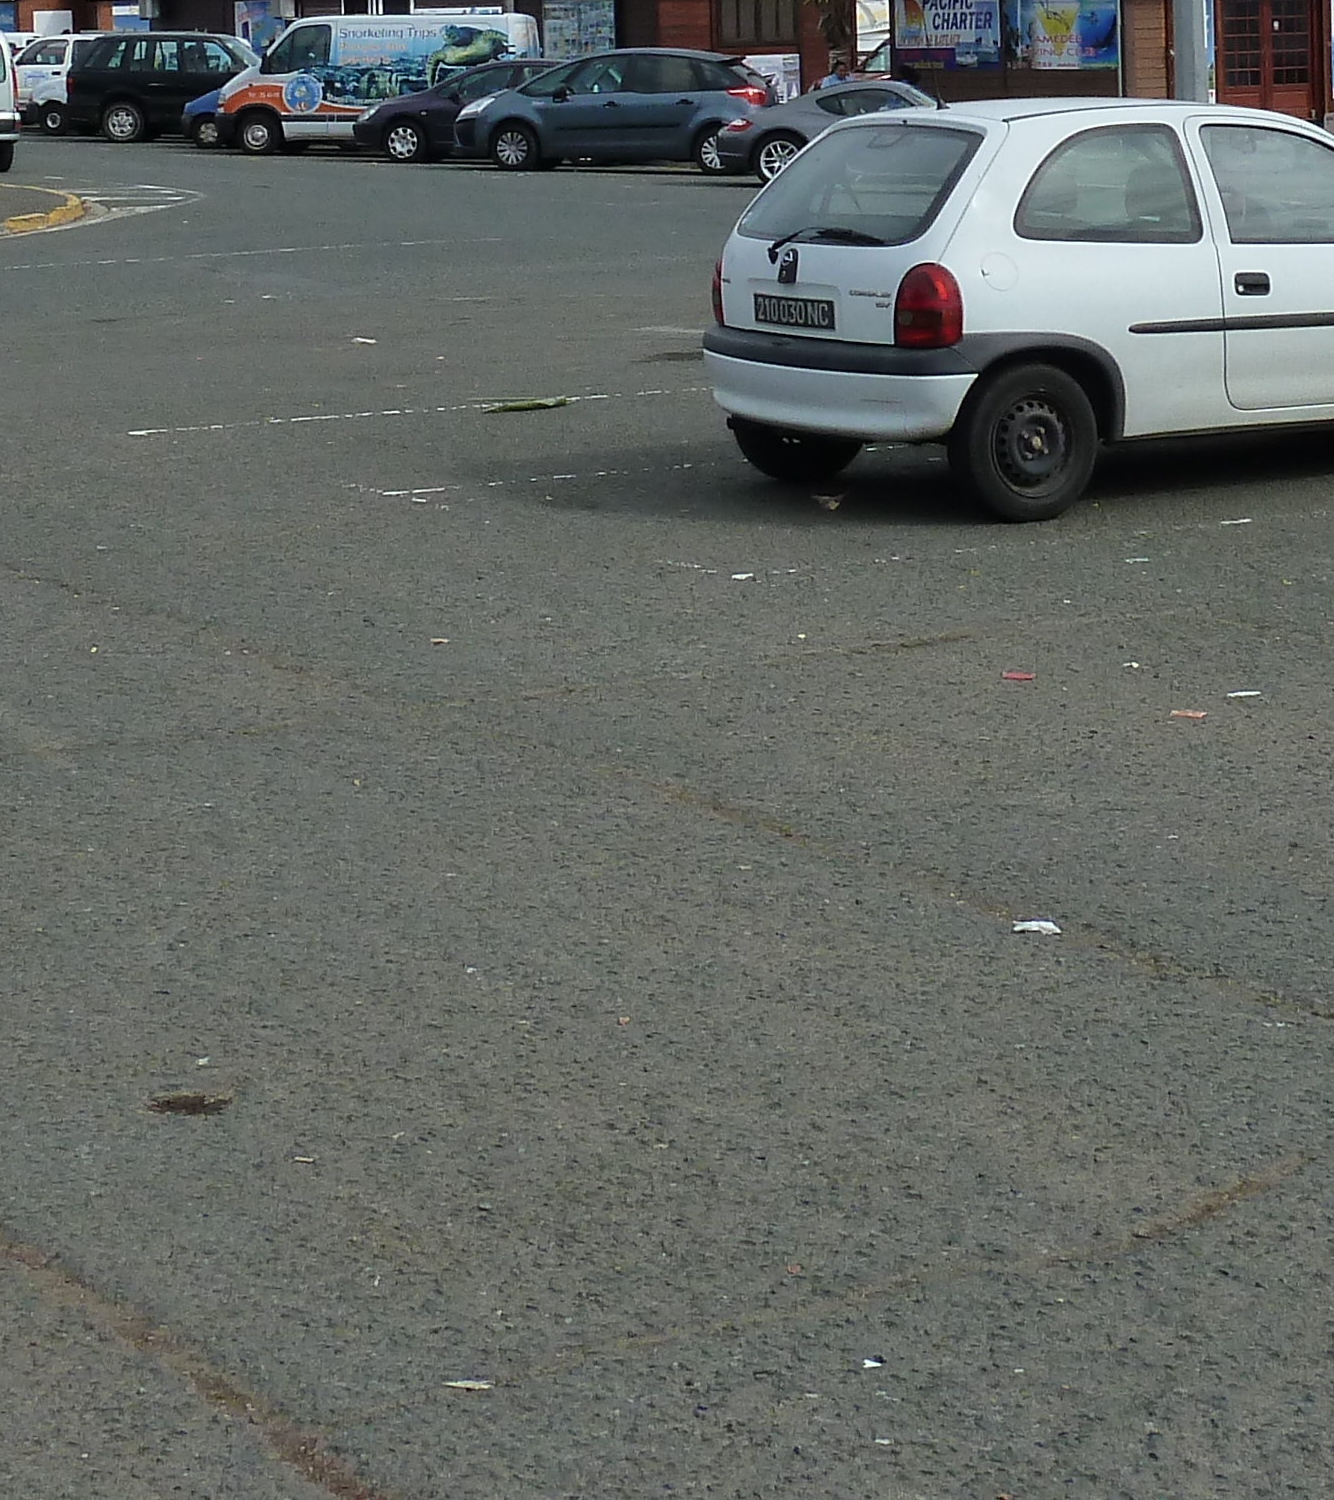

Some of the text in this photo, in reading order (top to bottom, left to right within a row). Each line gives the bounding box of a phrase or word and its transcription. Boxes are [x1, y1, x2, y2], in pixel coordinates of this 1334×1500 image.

[932, 11, 993, 31] CHARTER
[339, 27, 437, 40] Snorkeling Trips
